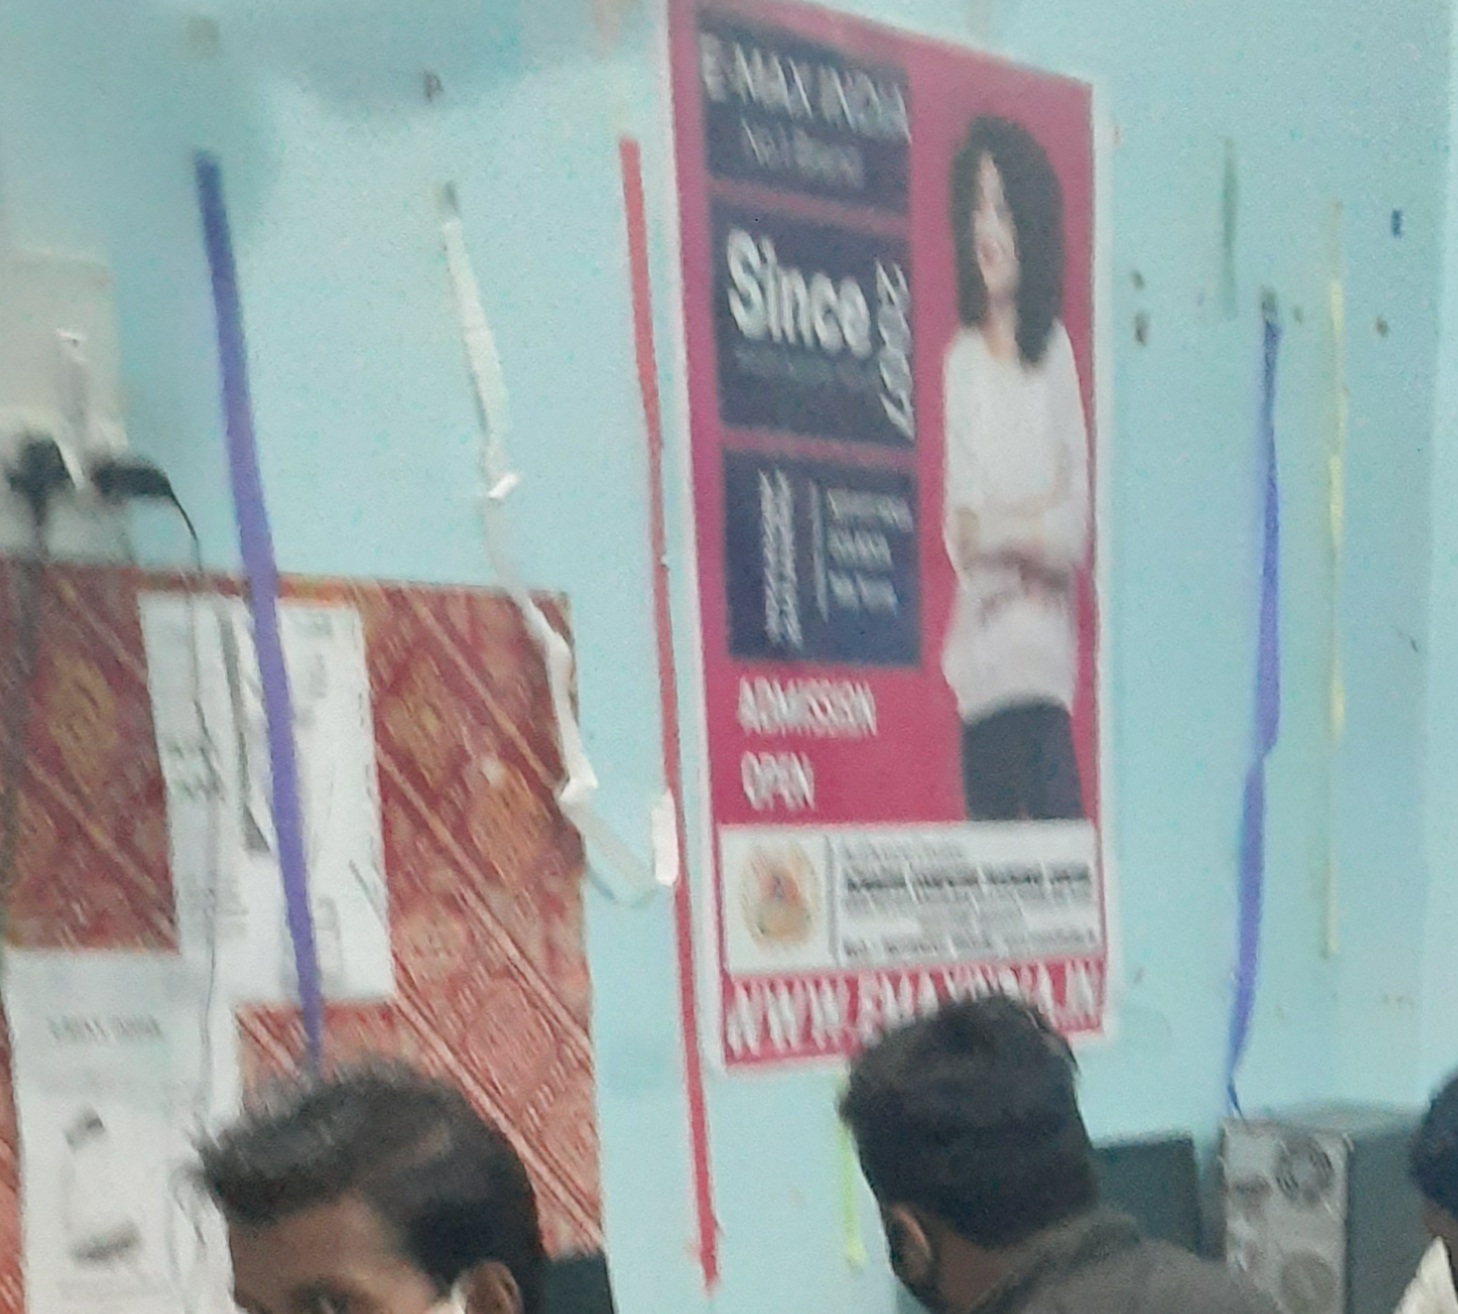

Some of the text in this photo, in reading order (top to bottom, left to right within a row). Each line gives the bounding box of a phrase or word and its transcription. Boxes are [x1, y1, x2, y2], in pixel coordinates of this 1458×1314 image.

[726, 228, 871, 359] Since
[873, 256, 915, 441] 2007
[738, 675, 877, 739] ADMISSION
[740, 752, 815, 811] OPEN
